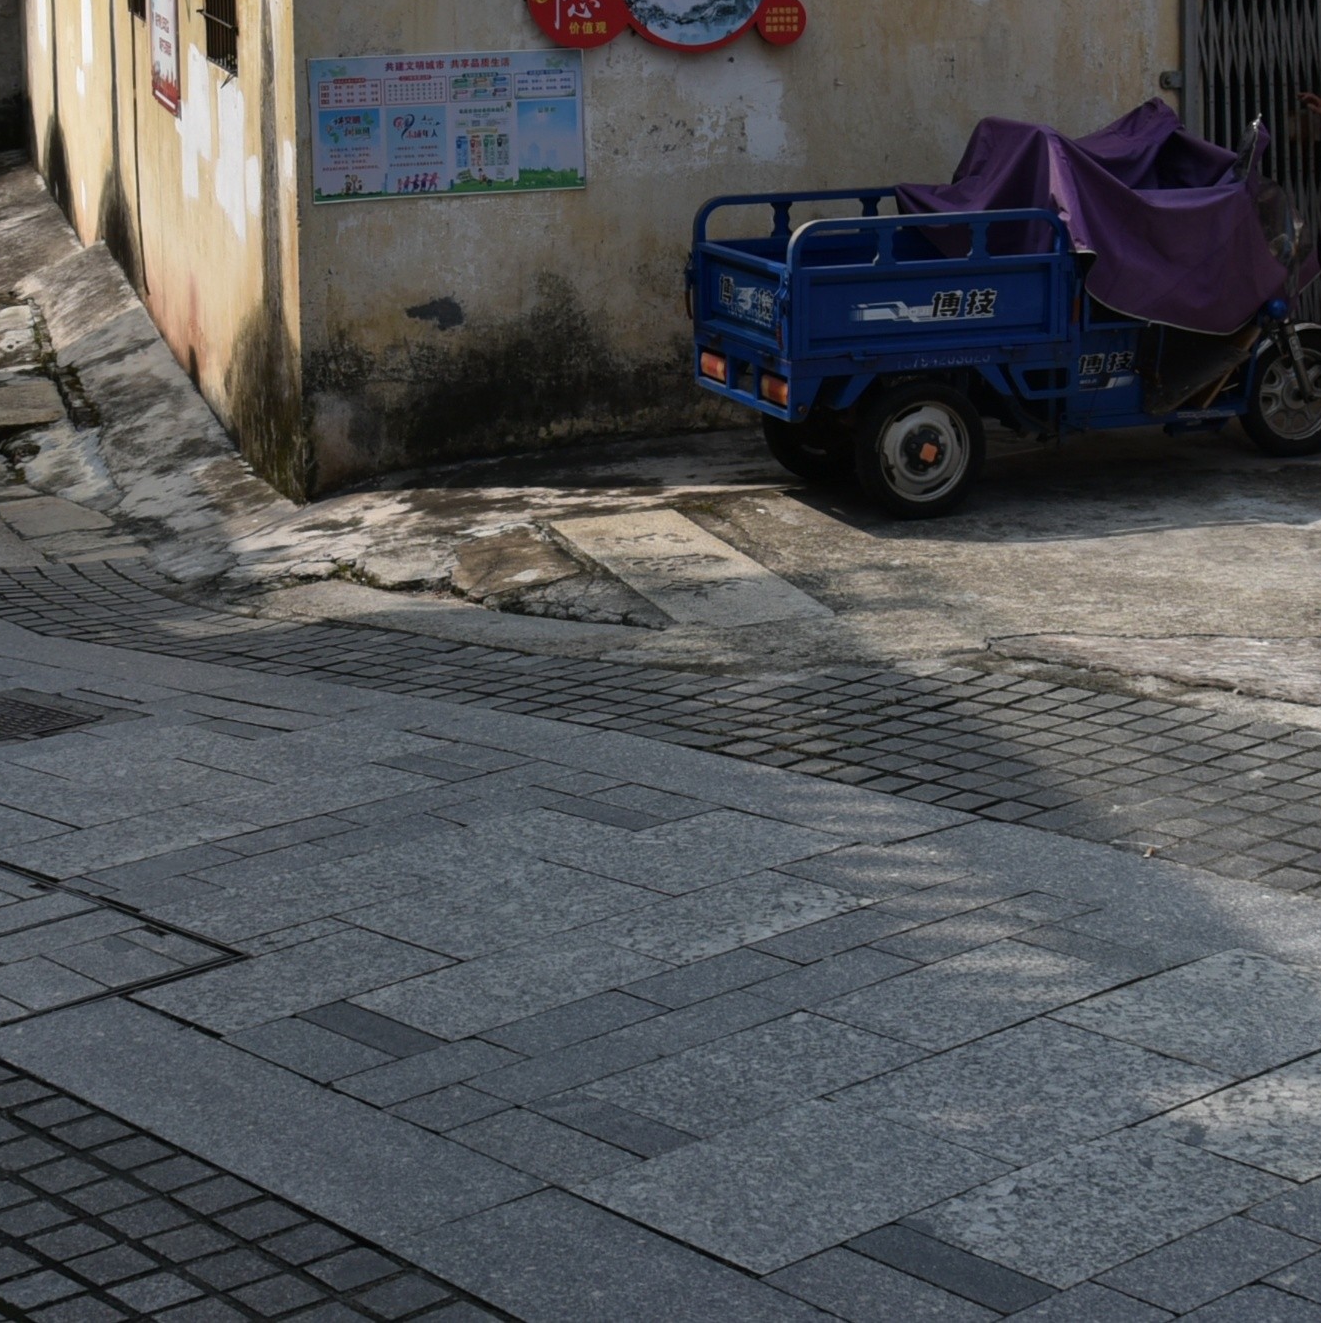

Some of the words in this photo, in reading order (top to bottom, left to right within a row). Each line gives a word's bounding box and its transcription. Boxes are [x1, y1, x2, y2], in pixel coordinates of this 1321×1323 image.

[569, 21, 608, 36] 价值观
[384, 58, 445, 72] 共建文明城市
[450, 57, 510, 70] 共享品质生活
[931, 287, 998, 318] 博技
[1079, 351, 1135, 376] 博技
